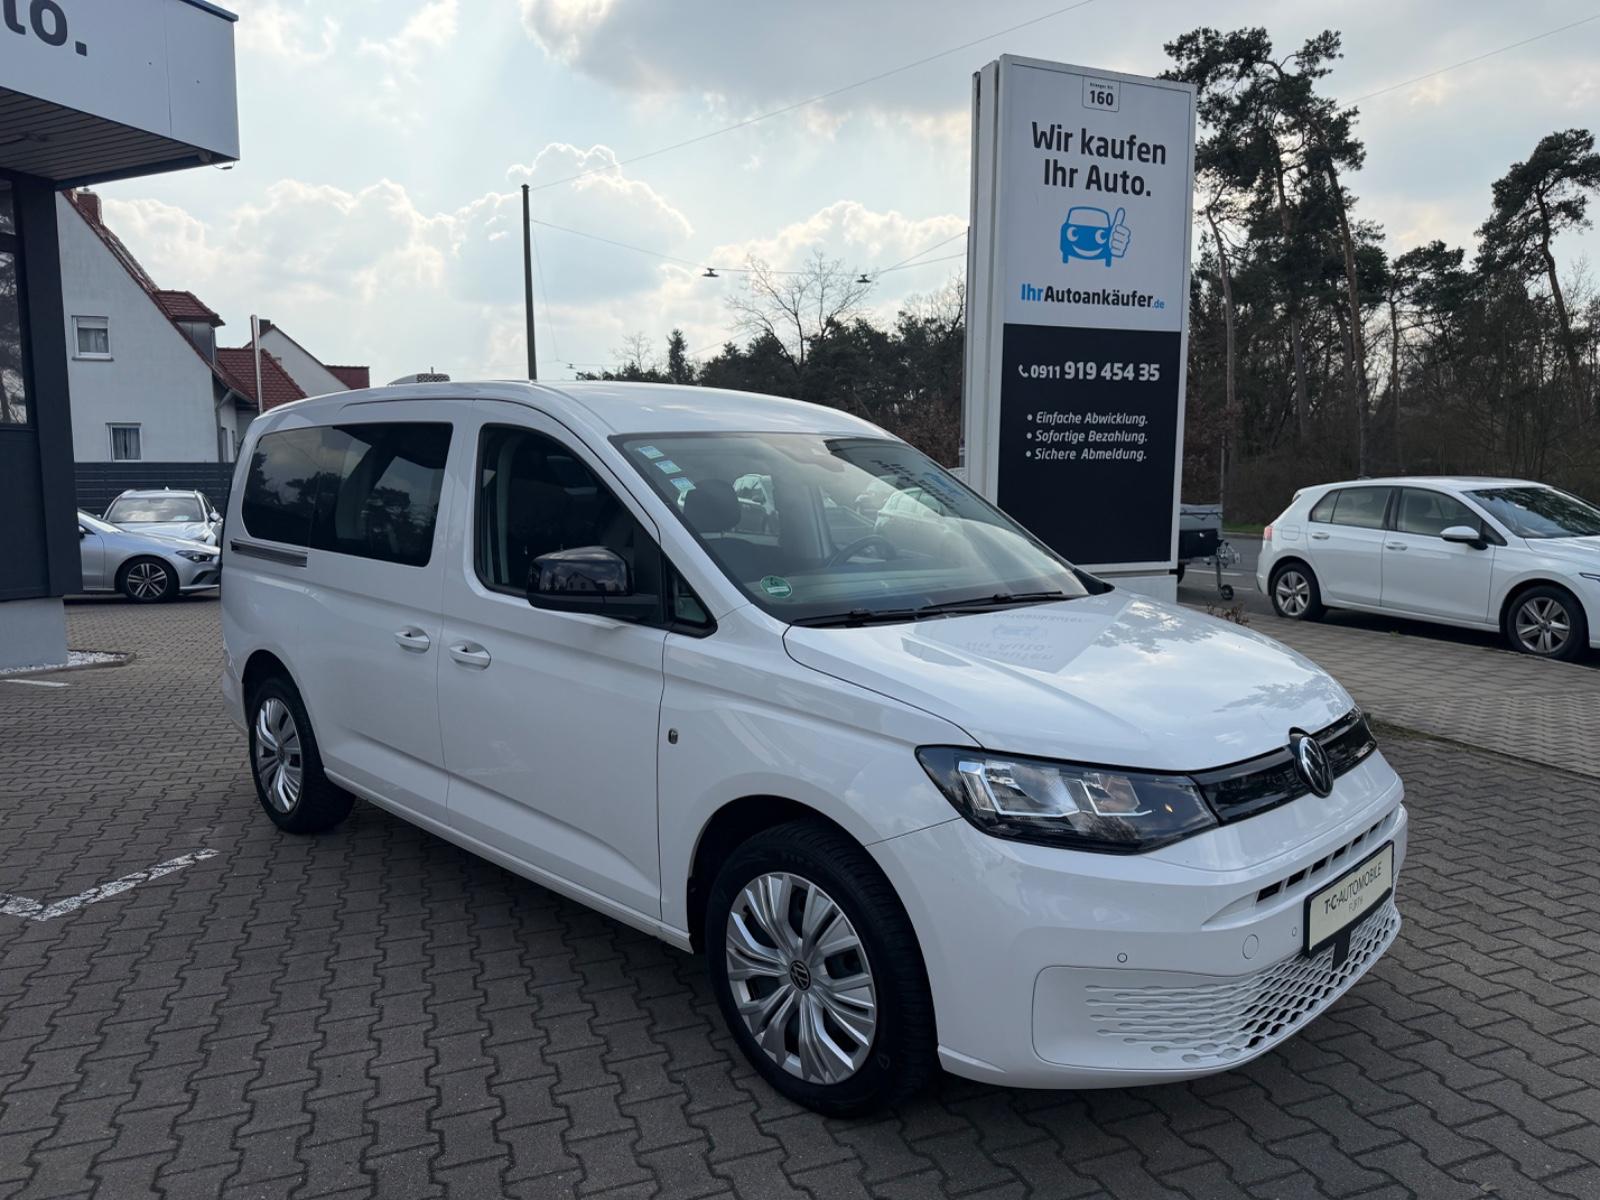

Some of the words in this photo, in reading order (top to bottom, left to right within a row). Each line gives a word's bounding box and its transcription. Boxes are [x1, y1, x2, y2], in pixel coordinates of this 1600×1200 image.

[1089, 90, 1114, 106] 160
[1032, 121, 1073, 152] Wir
[1081, 128, 1166, 165] kaufen
[1044, 159, 1078, 188] Ihr
[1085, 165, 1151, 197] Auto.
[1030, 365, 1060, 379] 0911
[1064, 361, 1097, 380] 919
[1101, 363, 1135, 381] 454
[1138, 364, 1160, 381] 35
[1036, 411, 1081, 426] Einfache
[1084, 412, 1148, 427] Abwicklung.
[1035, 430, 1085, 445] Sofortige
[1088, 430, 1148, 445] Bezahlung.
[1034, 448, 1076, 460] Sichere
[1081, 448, 1147, 462] Abmeldung.
